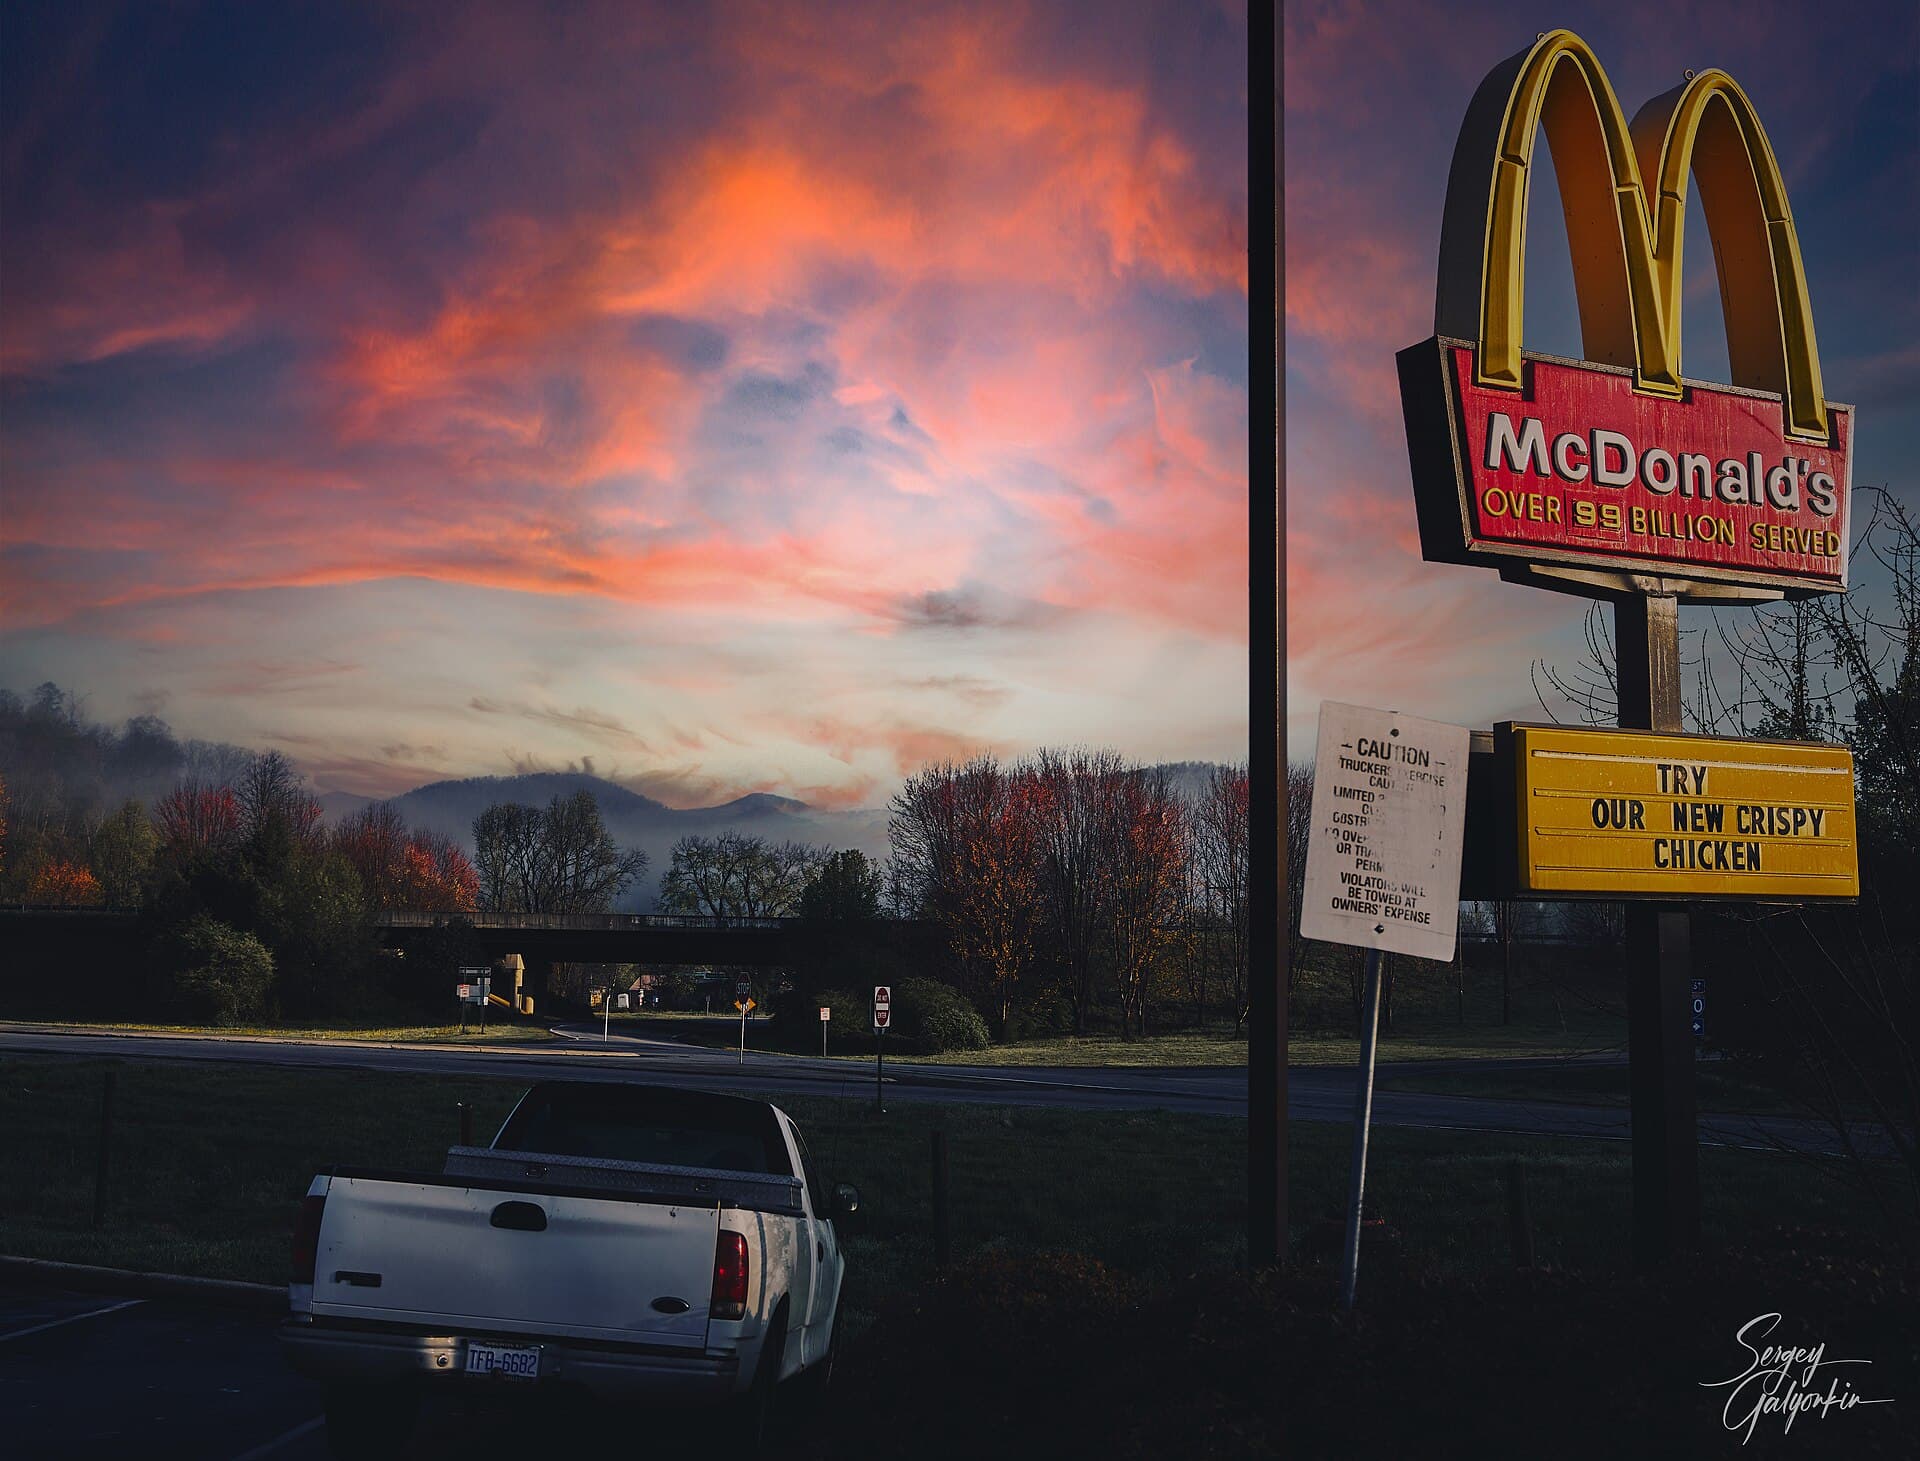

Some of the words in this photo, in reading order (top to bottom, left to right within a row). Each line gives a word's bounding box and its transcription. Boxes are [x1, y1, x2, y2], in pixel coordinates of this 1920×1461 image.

[1484, 411, 1838, 517] McDonald's
[1482, 487, 1562, 525] OVER
[1573, 500, 1622, 531] 99
[1630, 505, 1736, 547] BILLION
[1749, 521, 1842, 558] SERVED
[1357, 738, 1430, 767] CAUTION
[1656, 763, 1707, 795] TRY
[1333, 785, 1375, 803] LIMITED
[1591, 798, 1646, 830] OUR
[1673, 802, 1725, 833] NEW
[1736, 804, 1826, 837] CRISPY
[1336, 841, 1352, 855] OR
[1654, 838, 1761, 872] CHICKEN
[1348, 886, 1362, 900] BE
[1364, 889, 1402, 906] TOWED
[1405, 896, 1417, 909] AT
[1384, 906, 1431, 925] EXPENSE
[737, 982, 750, 994] STOP
[470, 1349, 537, 1375] TFB-6682
